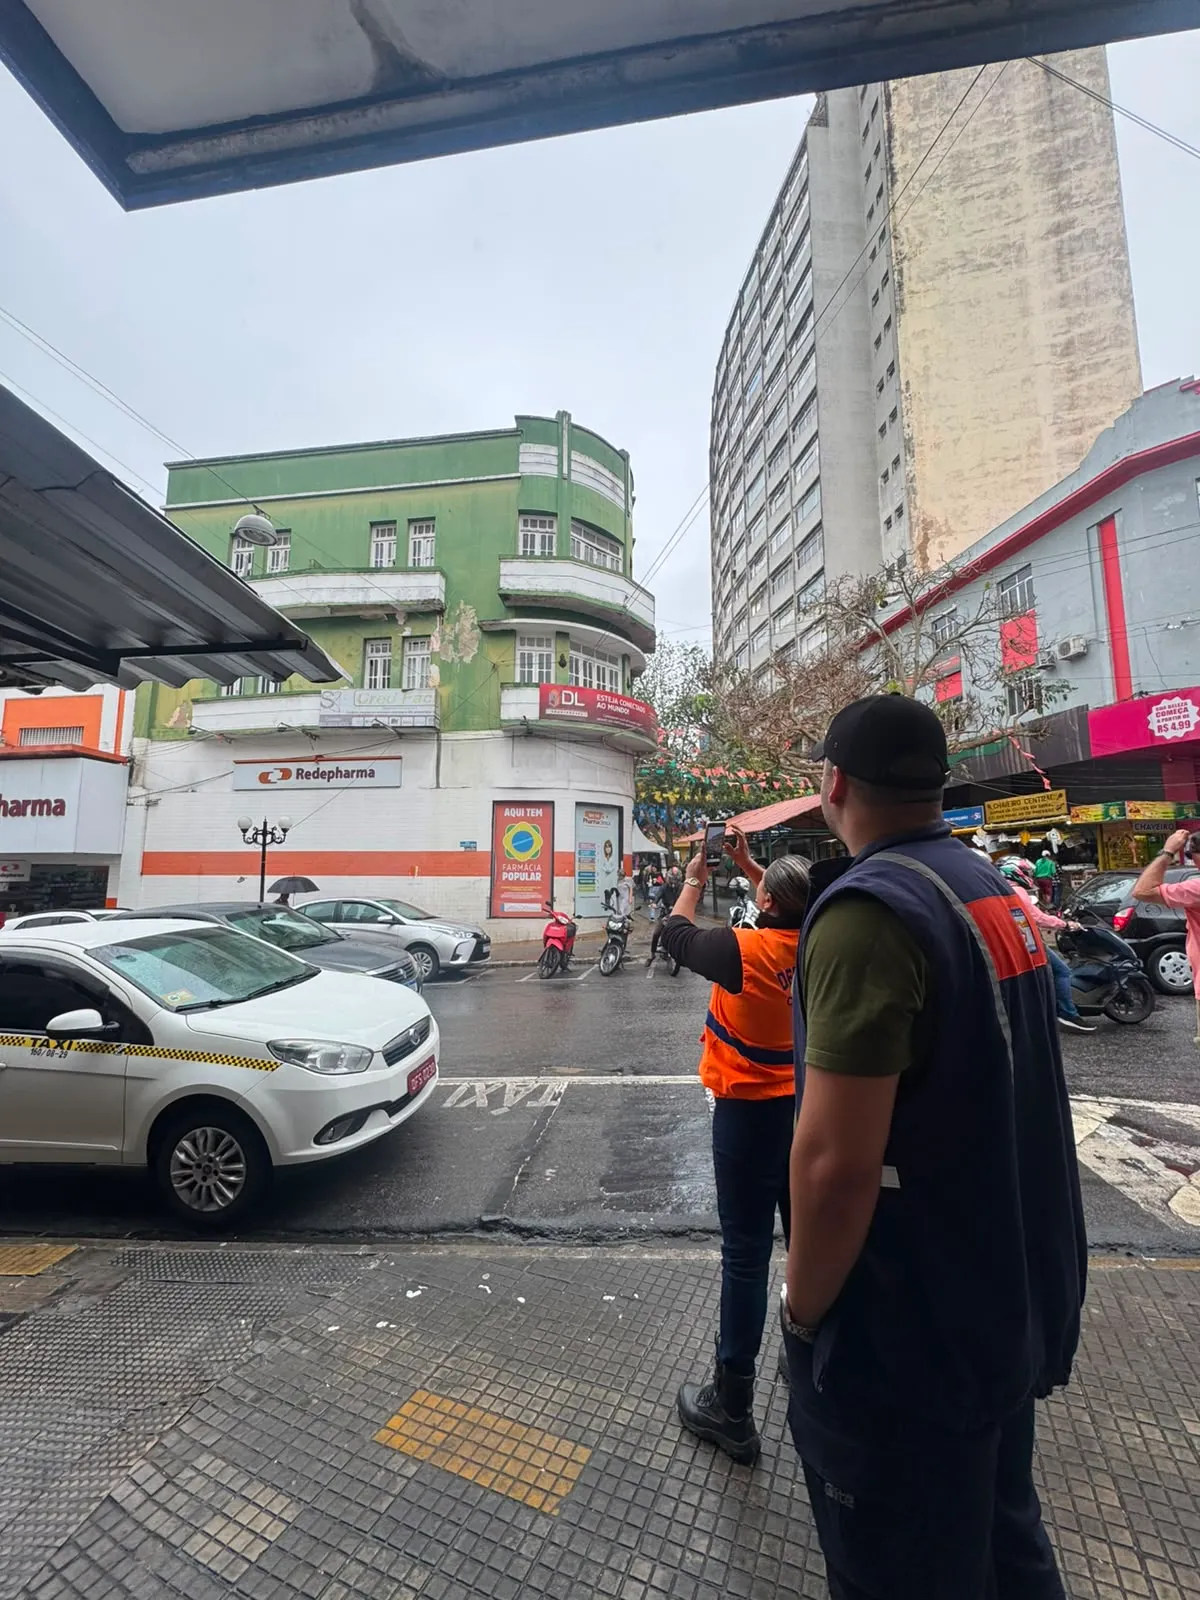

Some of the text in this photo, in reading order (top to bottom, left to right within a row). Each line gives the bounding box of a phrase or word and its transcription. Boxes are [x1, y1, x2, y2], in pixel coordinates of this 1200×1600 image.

[561, 690, 585, 706] DL
[596, 693, 619, 705] ESTEJA
[596, 702, 606, 710] AO
[1168, 701, 1188, 709] BELEZA
[1155, 707, 1189, 718] COMEÇA
[1157, 723, 1169, 733] R$
[295, 766, 375, 783] Redepharma
[504, 807, 543, 818] AQUI TEM
[1134, 823, 1174, 831] CHAVEIRO
[502, 862, 542, 872] FARMÁCIA
[502, 871, 542, 881] POPULAR
[30, 1037, 73, 1050] TAXI
